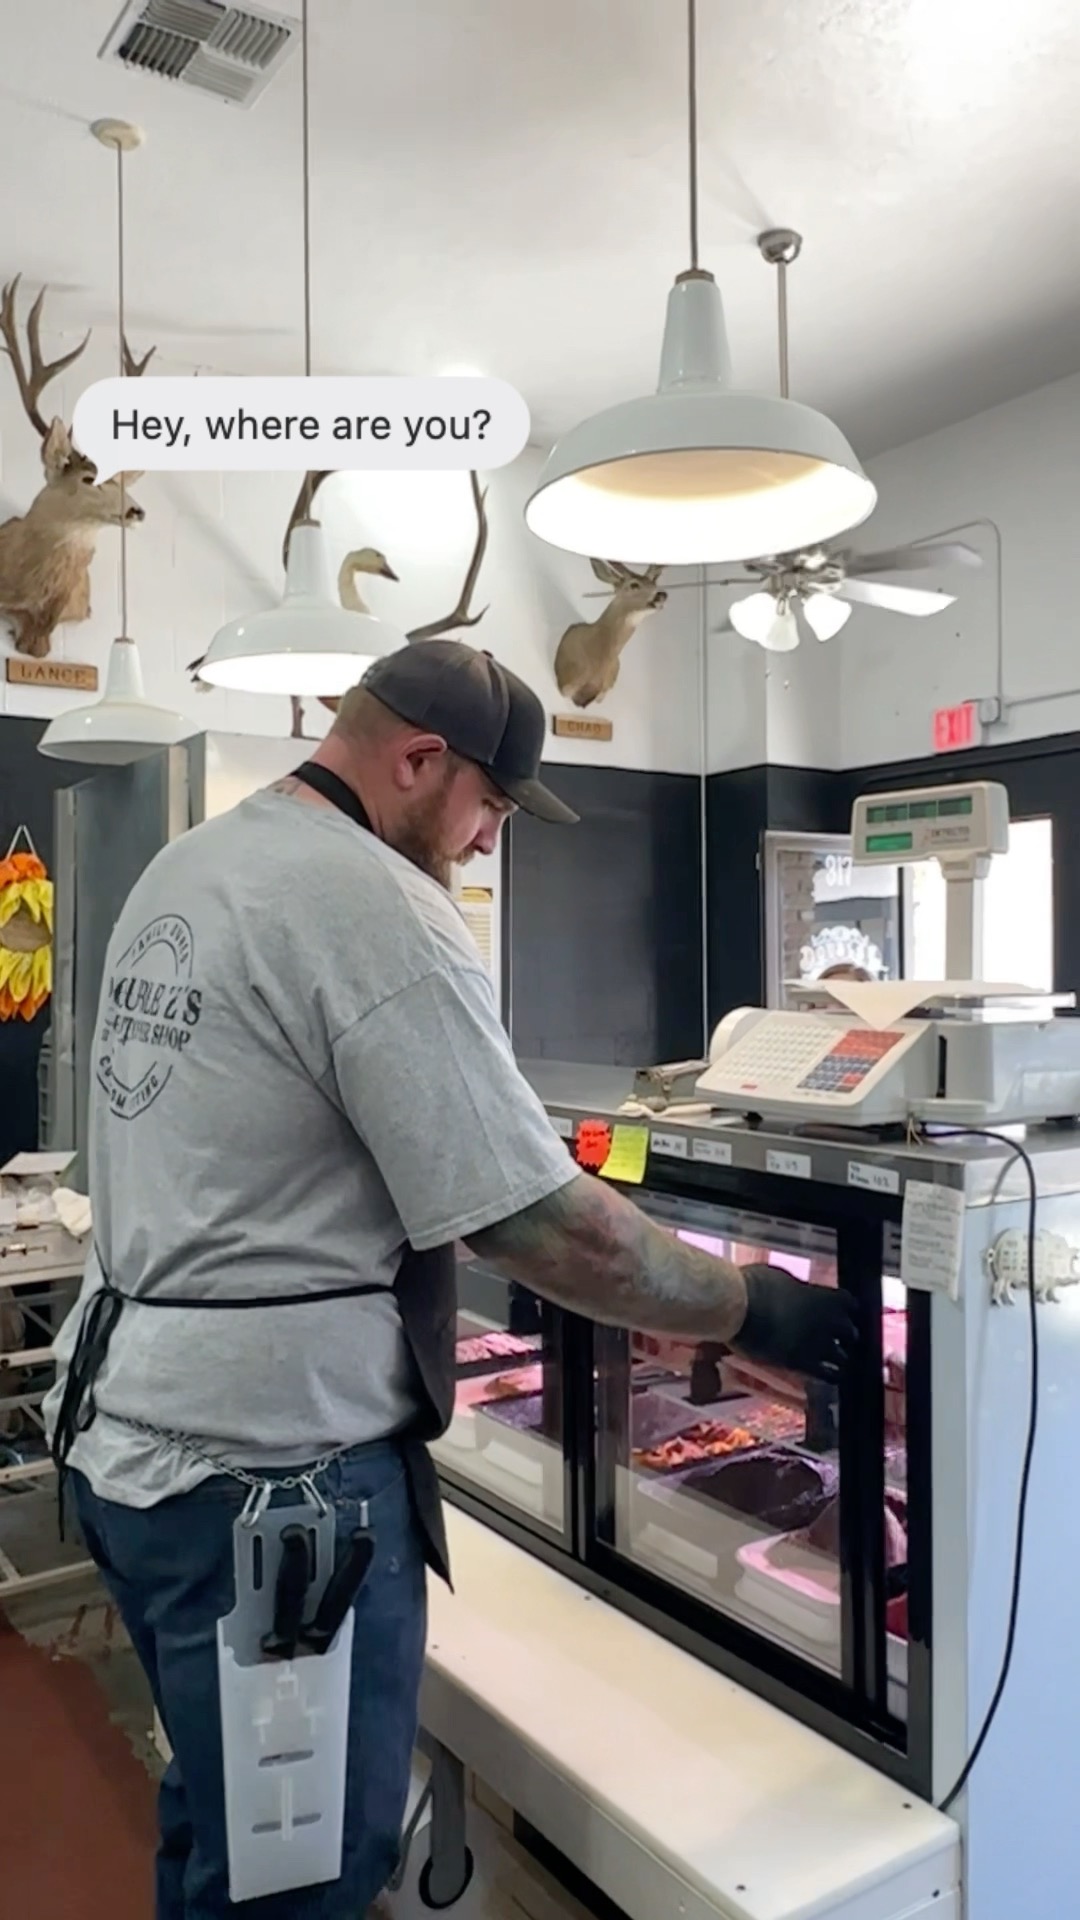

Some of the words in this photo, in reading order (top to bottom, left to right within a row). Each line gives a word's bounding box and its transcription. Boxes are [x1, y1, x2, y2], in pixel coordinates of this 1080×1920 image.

[20, 663, 87, 684] LANCE
[935, 704, 974, 748] EXIT
[150, 1023, 191, 1052] SHOP
